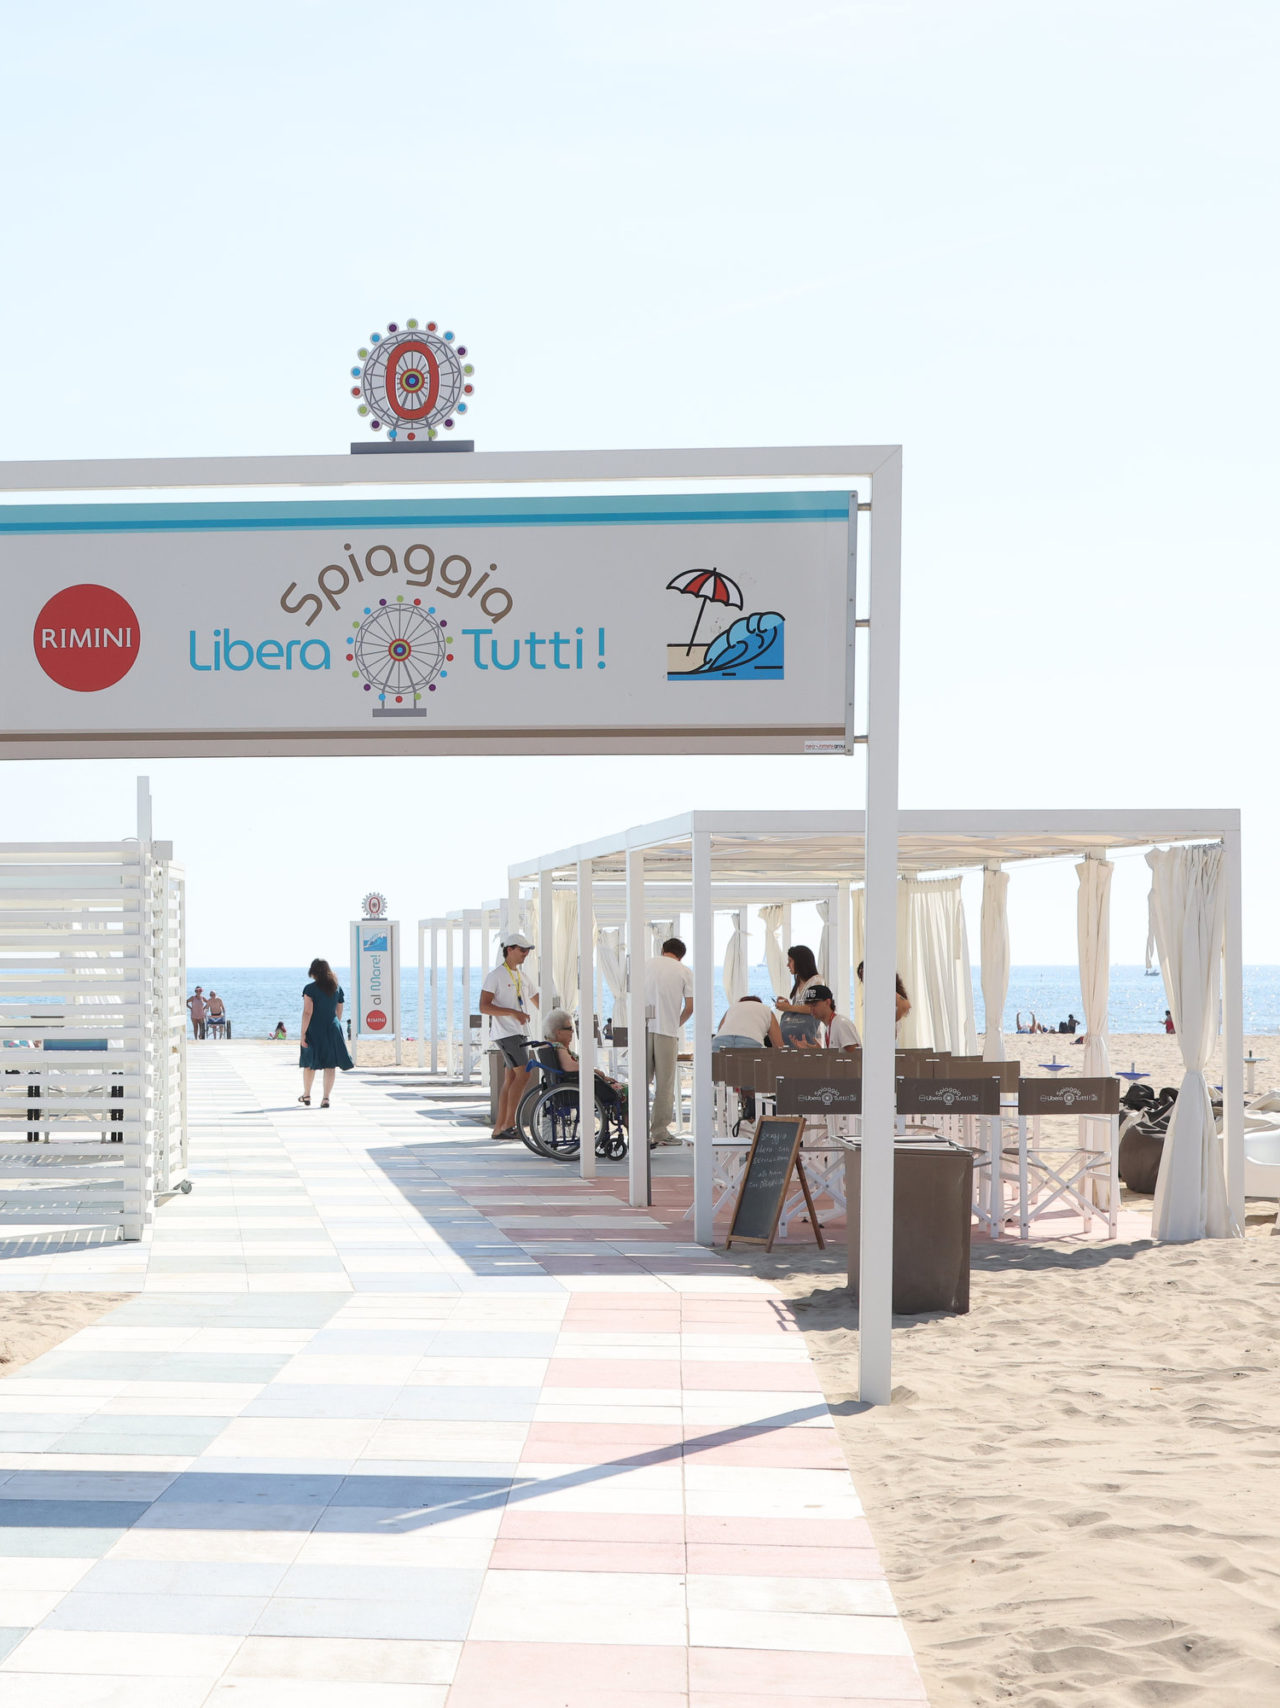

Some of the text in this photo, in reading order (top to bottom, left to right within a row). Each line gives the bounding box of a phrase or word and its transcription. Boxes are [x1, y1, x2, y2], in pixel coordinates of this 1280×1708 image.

[280, 543, 513, 627] Spiaggia
[41, 627, 132, 648] RIMINI
[189, 628, 331, 671] Libera
[370, 954, 382, 1006] al Mare!
